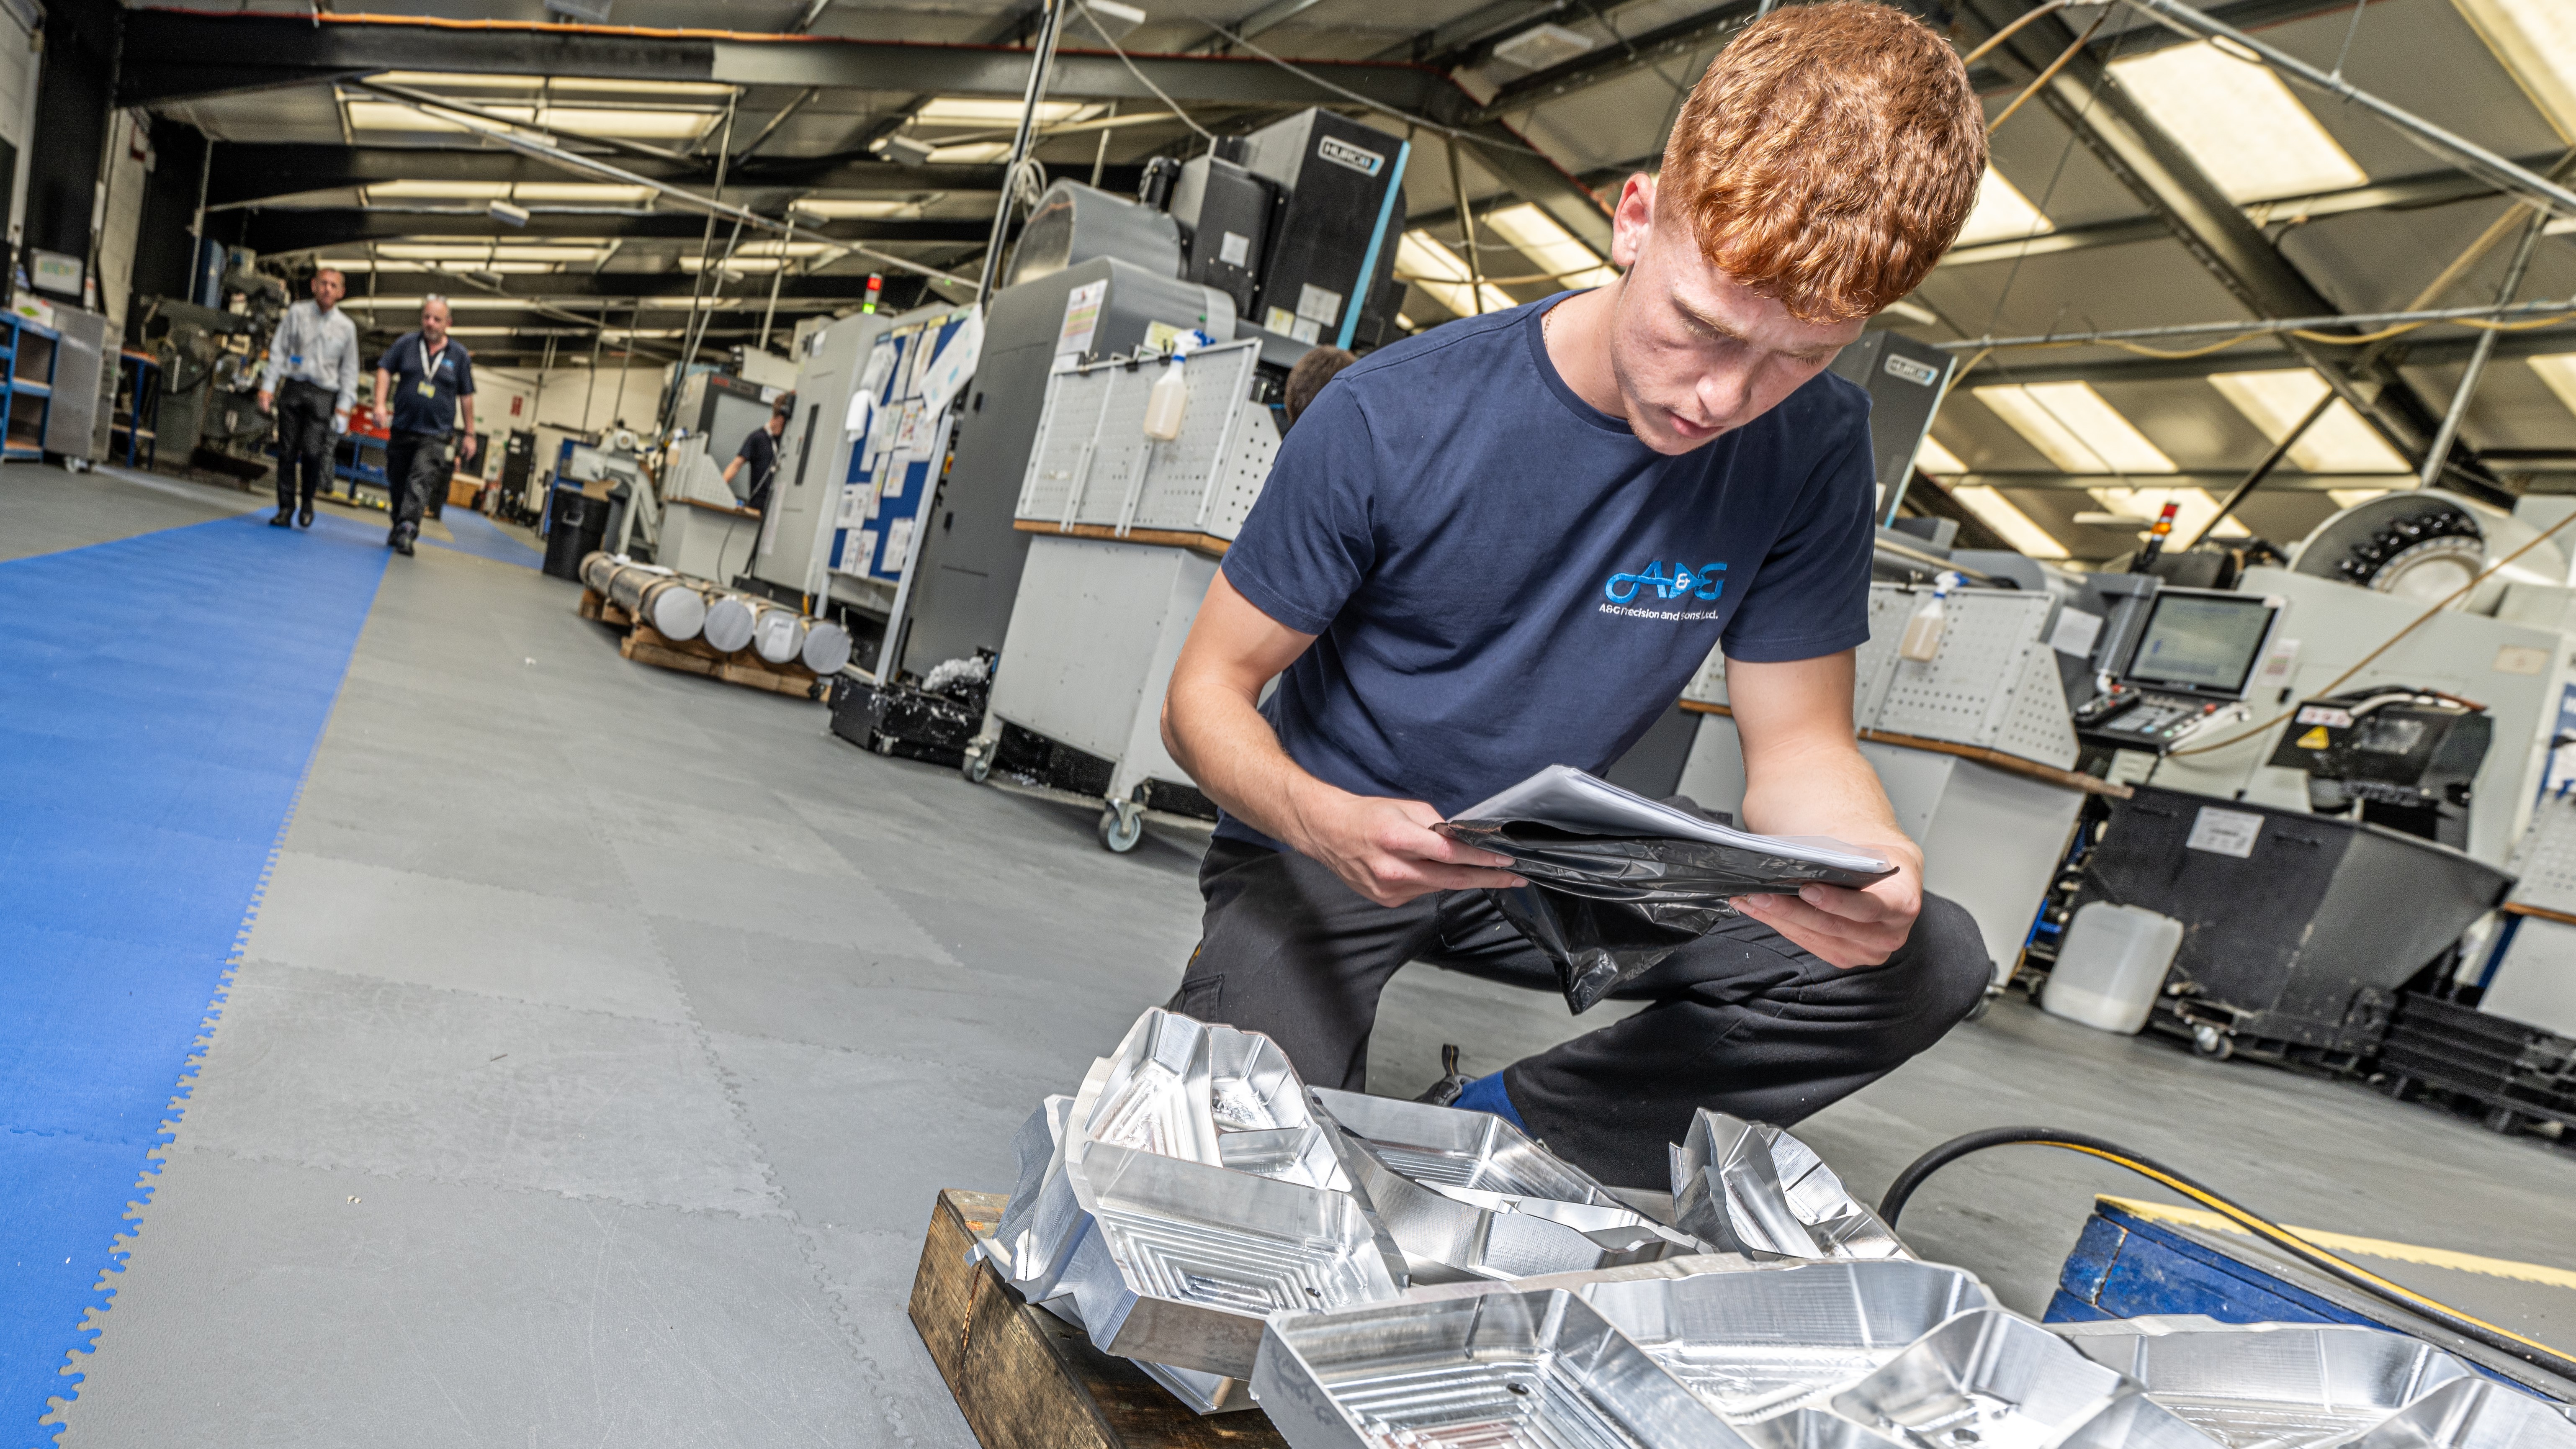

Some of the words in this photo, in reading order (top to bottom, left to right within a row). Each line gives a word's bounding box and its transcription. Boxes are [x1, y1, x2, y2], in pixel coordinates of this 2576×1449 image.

[1599, 603, 1621, 614] A&G
[1620, 607, 1660, 619] Precision
[1660, 611, 1680, 621] and
